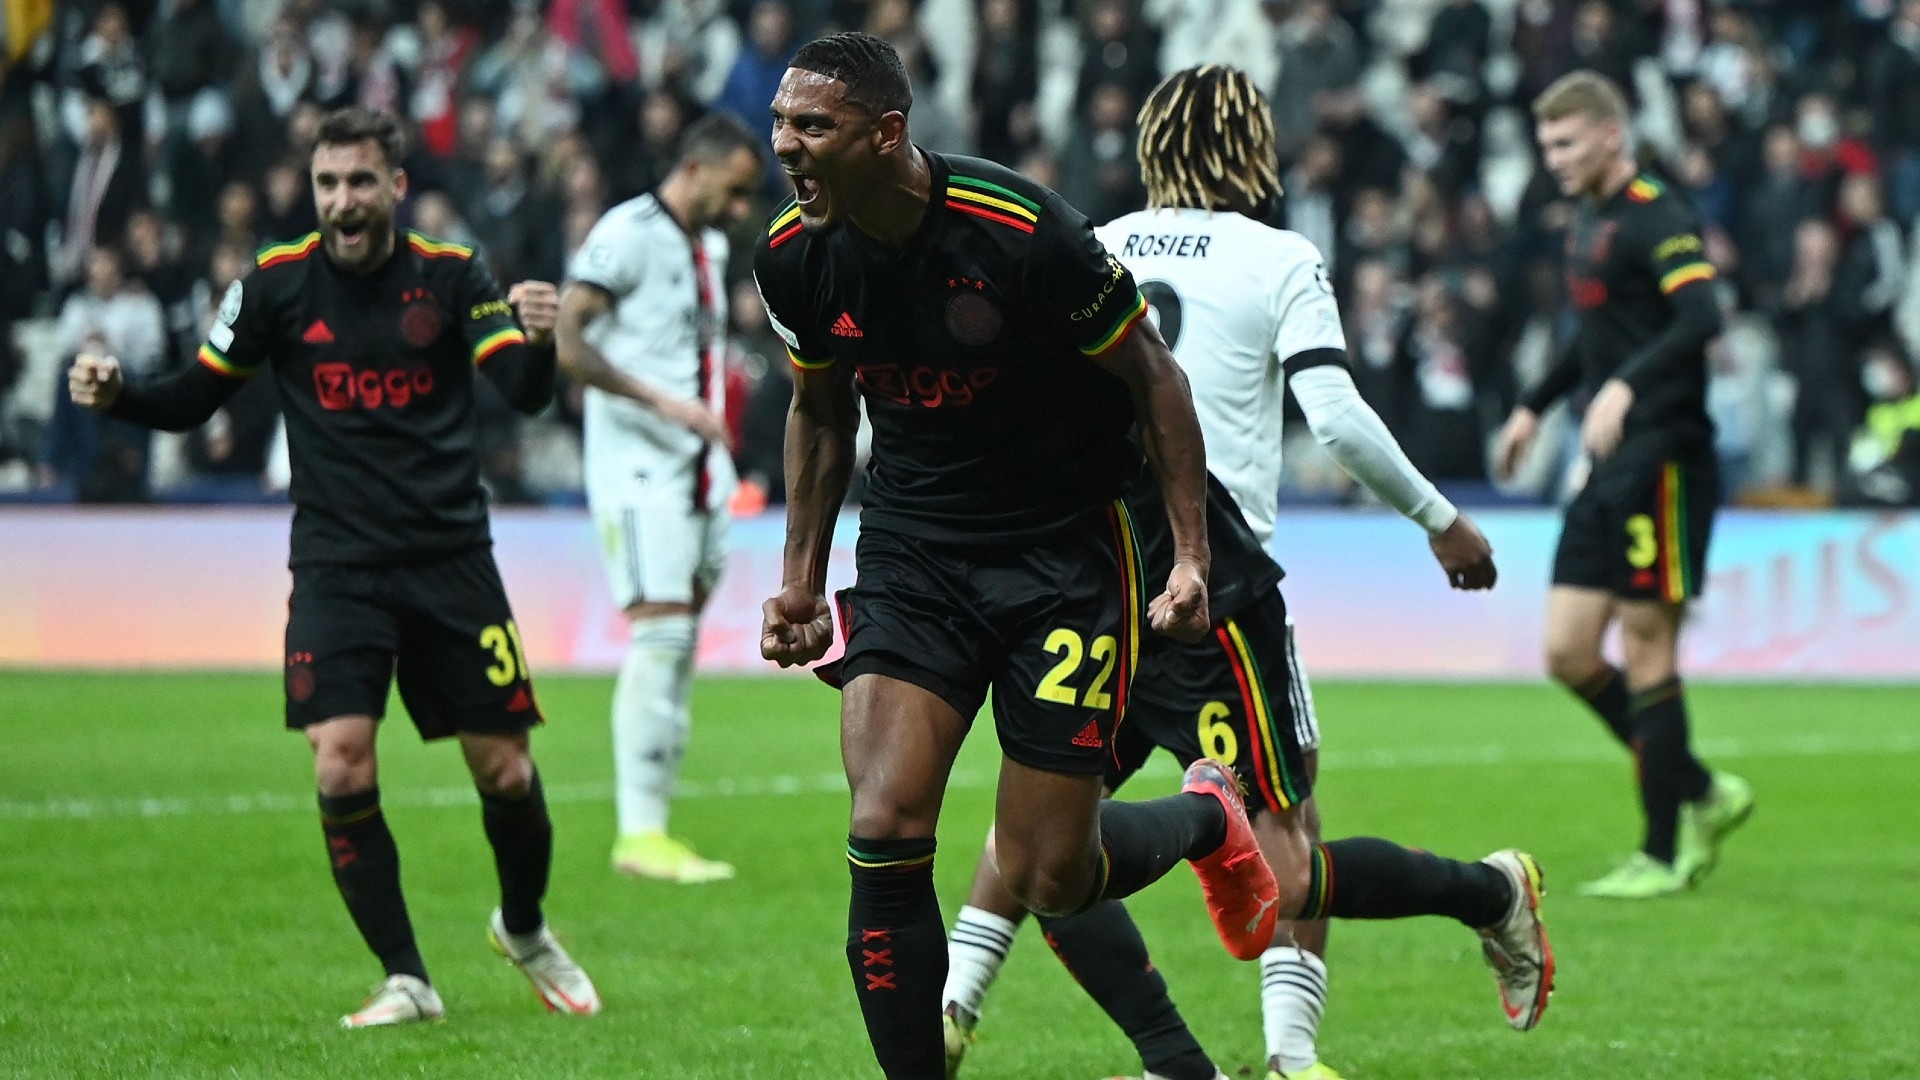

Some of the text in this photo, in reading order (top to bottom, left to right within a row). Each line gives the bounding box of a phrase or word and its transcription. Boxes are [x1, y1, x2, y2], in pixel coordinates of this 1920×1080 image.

[1121, 234, 1211, 258] ROSIER
[1625, 513, 1658, 569] 3
[1034, 628, 1117, 709] 22
[1071, 737, 1104, 748] adidas
[1197, 701, 1238, 767] 6
